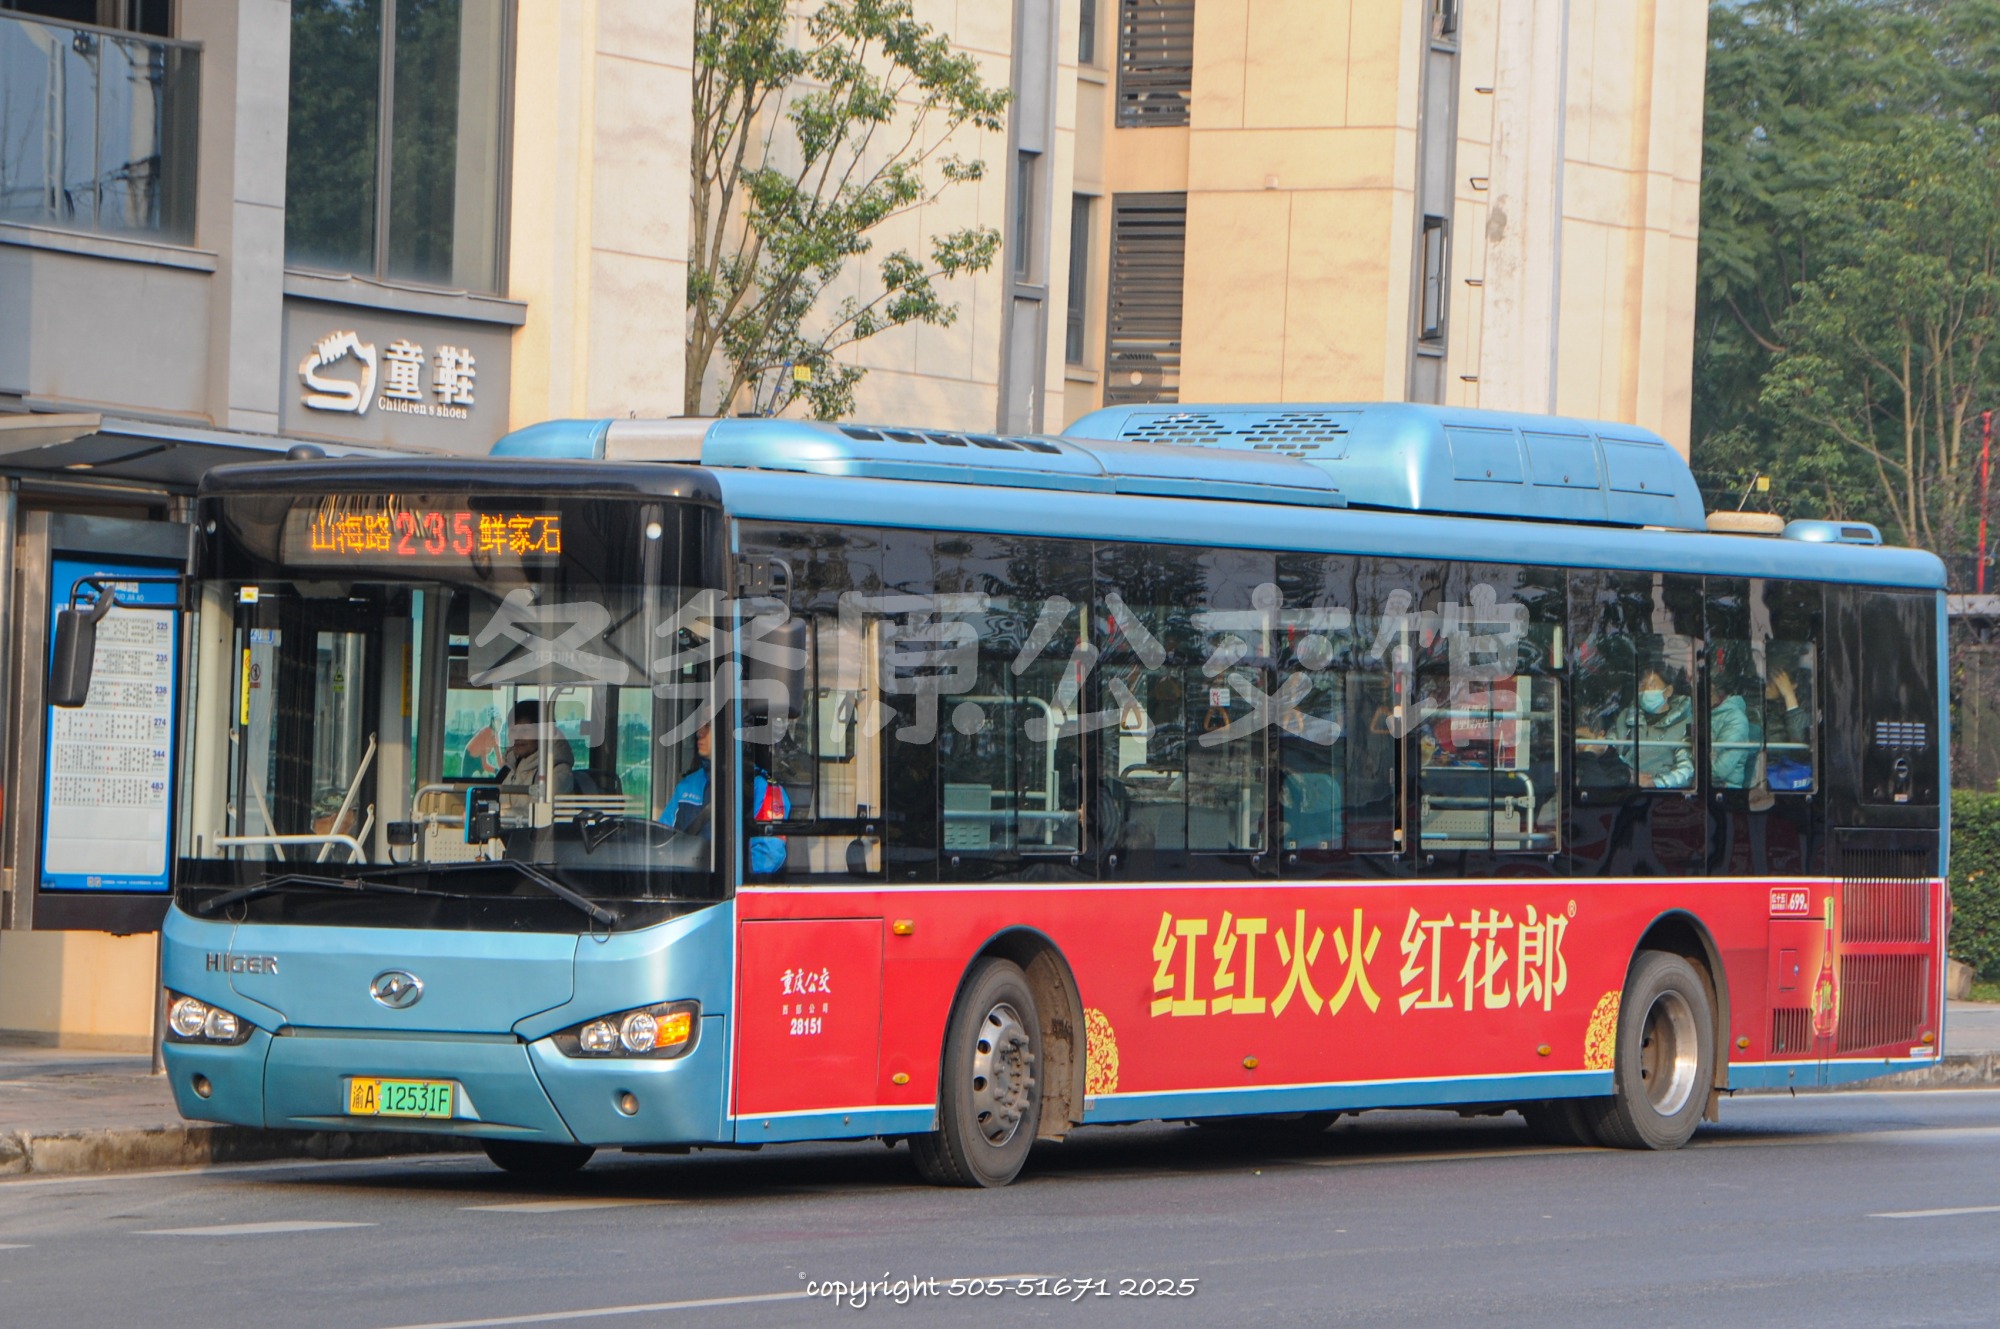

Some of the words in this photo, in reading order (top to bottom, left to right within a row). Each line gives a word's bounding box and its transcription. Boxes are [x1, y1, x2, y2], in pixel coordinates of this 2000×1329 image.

[384, 339, 476, 404] 童鞋
[378, 396, 427, 414] Children
[436, 404, 467, 419] shoes
[311, 512, 392, 554] 山海路
[395, 512, 474, 555] 235
[479, 513, 562, 556] 鲜家石
[205, 952, 279, 975] HIGER
[1151, 908, 1382, 1019] 红红火火
[780, 967, 832, 995] 重庆公交
[789, 1017, 822, 1036] 28151
